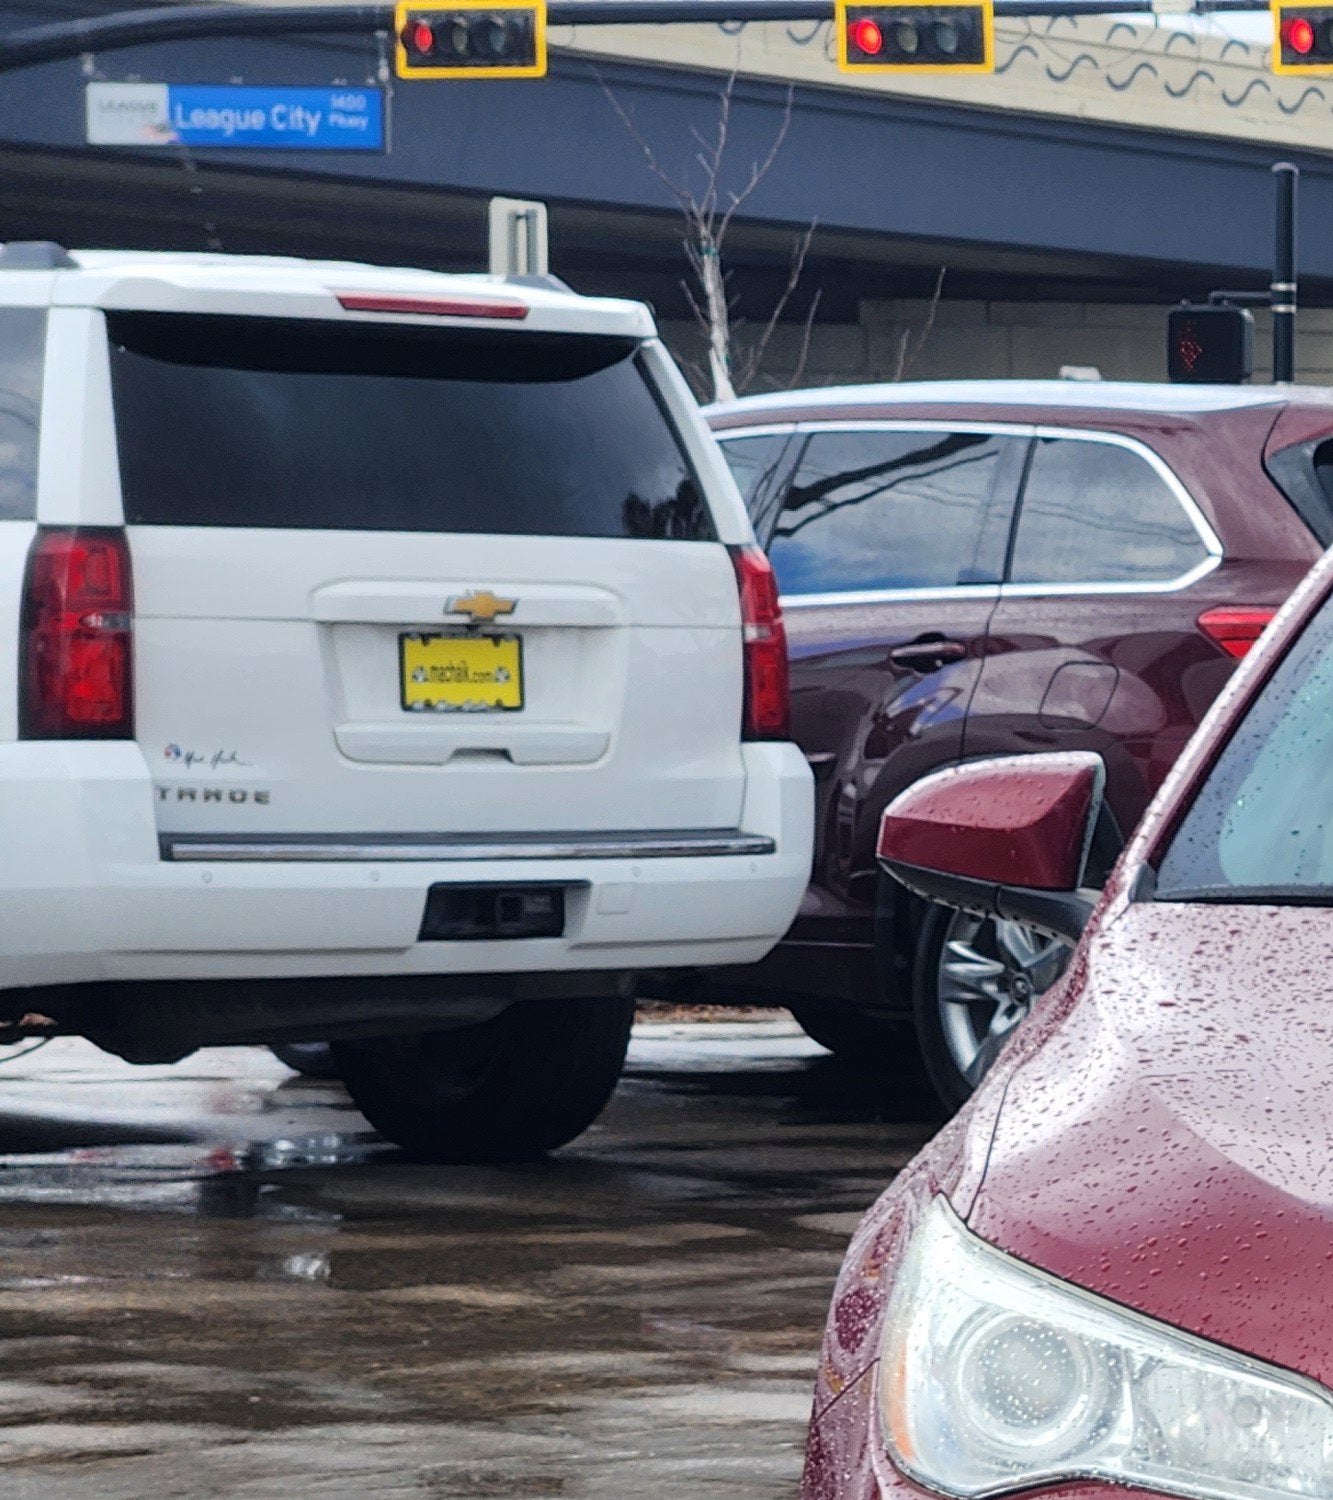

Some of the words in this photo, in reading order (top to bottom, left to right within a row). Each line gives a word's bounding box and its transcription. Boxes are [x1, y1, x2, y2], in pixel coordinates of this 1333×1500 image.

[175, 102, 266, 136] League
[270, 103, 322, 137] City
[156, 785, 271, 805] TAHOE
